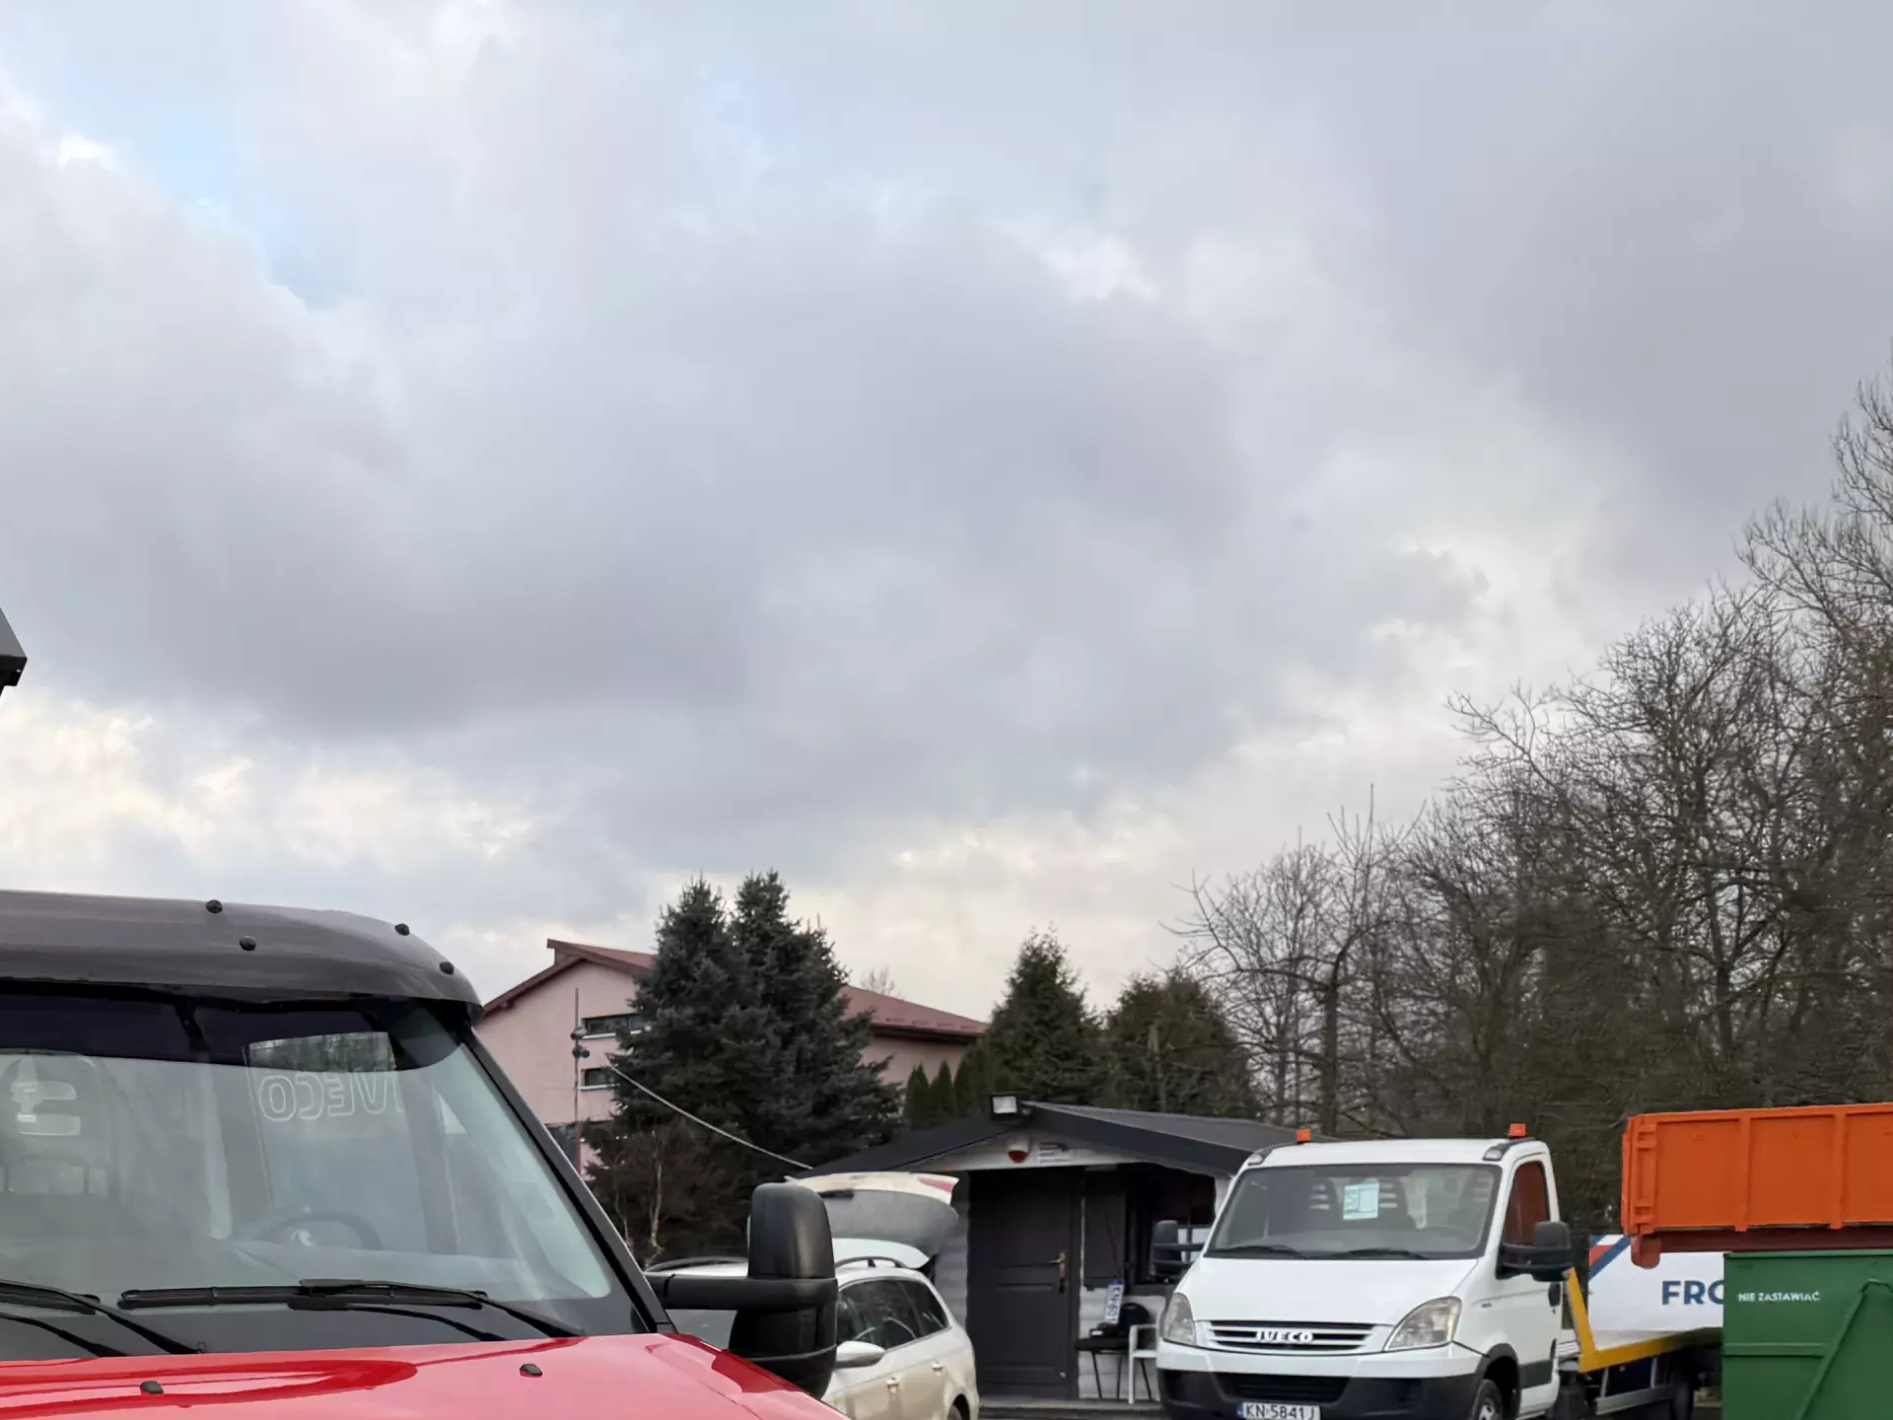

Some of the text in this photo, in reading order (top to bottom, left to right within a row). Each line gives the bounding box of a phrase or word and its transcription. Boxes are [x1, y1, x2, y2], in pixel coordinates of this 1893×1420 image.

[1736, 1291, 1820, 1302] NIE ZASTAWIAĆ
[1255, 1328, 1314, 1343] IVECO
[1246, 1404, 1315, 1420] KN 5841J
